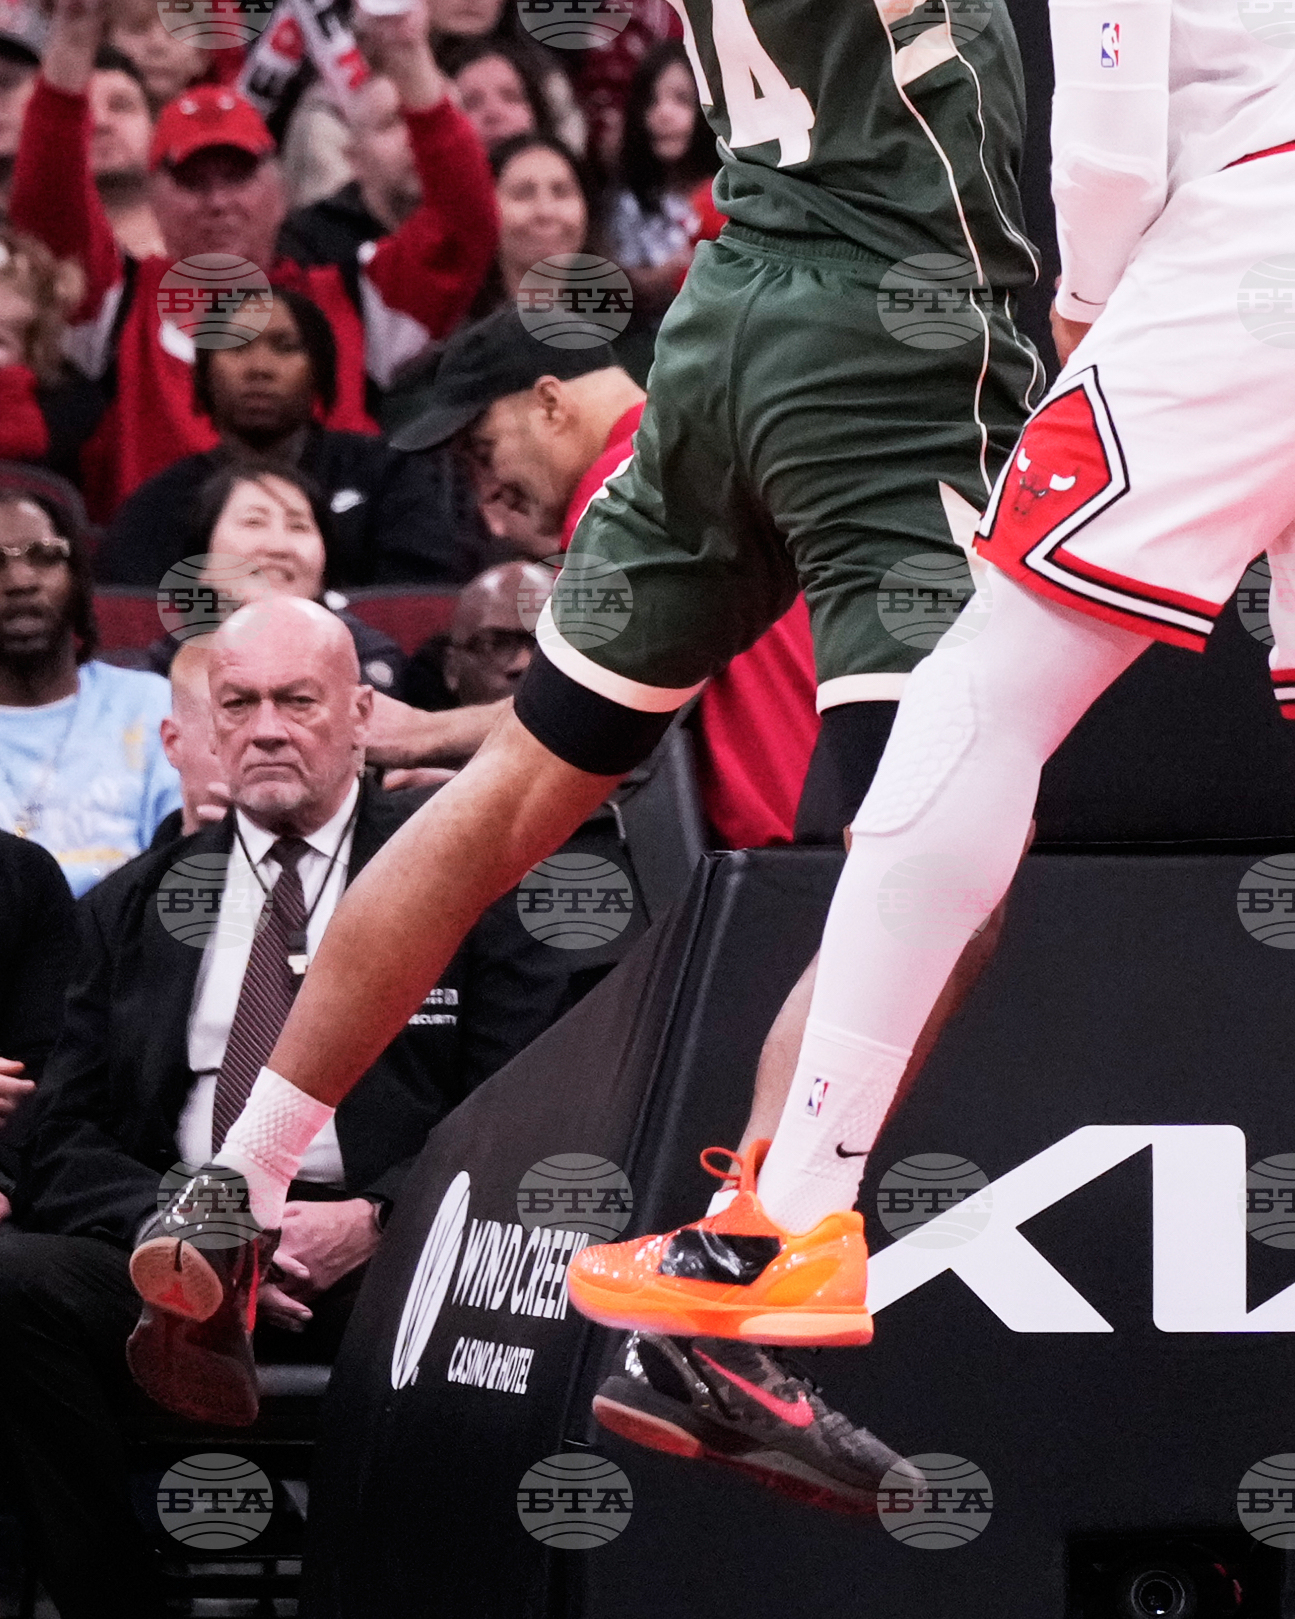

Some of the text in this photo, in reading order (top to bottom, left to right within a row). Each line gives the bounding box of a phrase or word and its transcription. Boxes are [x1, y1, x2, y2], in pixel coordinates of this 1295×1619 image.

[452, 1218, 523, 1311] WIND
[448, 1336, 495, 1388] CASINO
[494, 1345, 535, 1395] HOTEL
